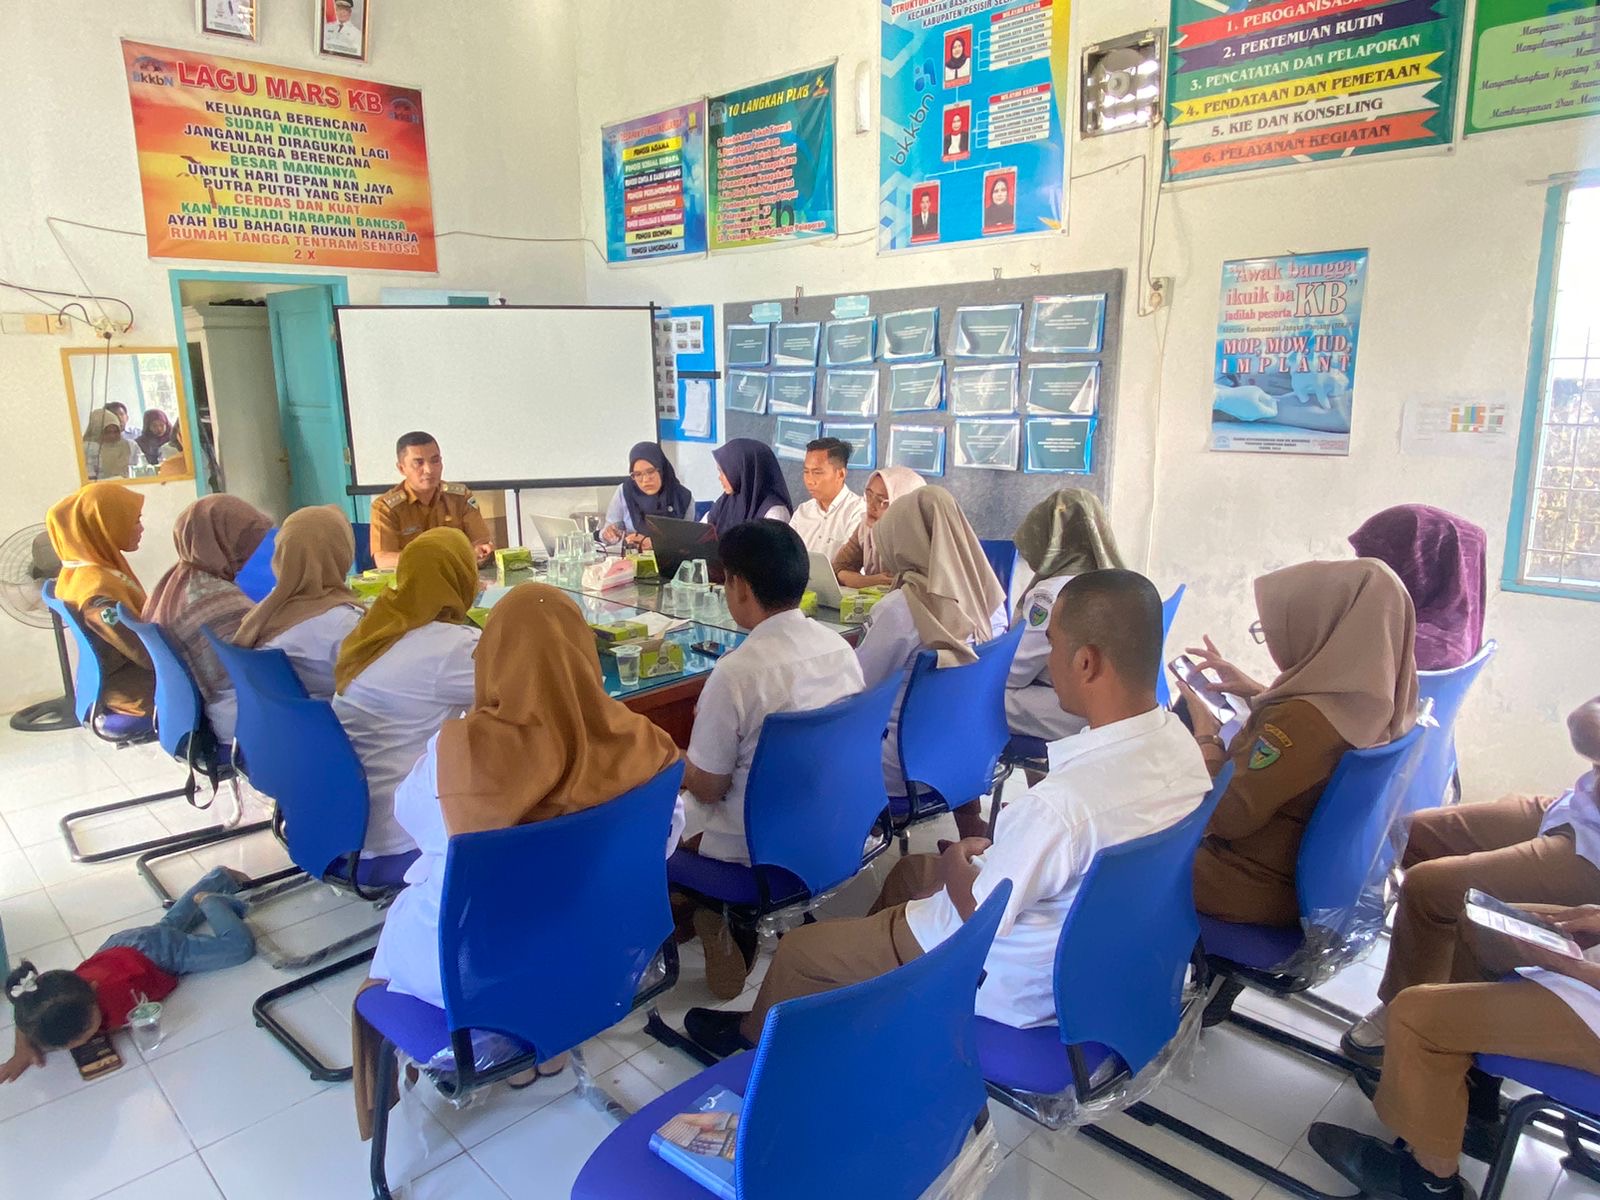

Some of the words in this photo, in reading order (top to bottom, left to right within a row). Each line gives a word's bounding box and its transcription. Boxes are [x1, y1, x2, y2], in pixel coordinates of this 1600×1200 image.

[908, 2, 947, 21] KECAMATAN
[923, 9, 962, 27] KABUPATEN
[1227, 19, 1239, 32] 1.
[1243, 0, 1362, 28] PEROGANISA
[1223, 46, 1236, 58] 2.
[1240, 24, 1331, 55] PERTEMUAN
[1335, 12, 1384, 35] RUTIN
[1190, 79, 1202, 91] 3.
[1206, 60, 1289, 89] PENCATATAN
[1293, 53, 1323, 70] DAN
[1327, 33, 1420, 64] PELAPORAN
[176, 60, 257, 96] LAGU
[264, 76, 341, 109] MARS
[347, 89, 384, 115] KB
[1186, 105, 1199, 117] 4.
[1204, 87, 1289, 114] PENDATAAN
[1293, 80, 1327, 97] DAN
[1331, 63, 1420, 90] PEMETAAN
[205, 101, 282, 121] KELUARGA
[286, 113, 368, 133] BERENCANA
[728, 103, 740, 118] 10
[741, 90, 784, 114] LANGKAH
[1211, 125, 1224, 137] 5.
[1229, 120, 1252, 134] KIE
[1257, 114, 1289, 129] DAN
[1293, 97, 1383, 123] KONSELING
[184, 124, 273, 145] JANGANLAH
[278, 135, 356, 155] DIRAGUKAN
[361, 147, 389, 159] LAGI
[224, 116, 274, 132] SUDAH
[279, 124, 354, 143] WAKTUNYA
[890, 94, 934, 165] bkkbn
[1202, 152, 1215, 163] 6.
[1220, 138, 1305, 161] PELAYANAN
[1309, 124, 1391, 147] KEGIATAN
[210, 140, 286, 159] KELUARGA
[290, 149, 371, 169] BERENCANA
[230, 155, 277, 170] BESAR
[282, 161, 357, 179] MAKNANYA
[188, 163, 240, 179] UNTUK
[244, 169, 279, 183] HARI
[284, 173, 328, 188] DEPAN
[333, 179, 359, 191] NAN
[364, 182, 394, 195] JAYA
[203, 177, 253, 192] PUTRA
[258, 183, 300, 197] PUTRI
[304, 187, 339, 201] YANG
[344, 192, 384, 206] SEHAT
[181, 202, 212, 215] KAN
[218, 205, 283, 220] MENJADI
[288, 211, 351, 226] HARAPAN
[356, 217, 406, 230] BANGSA
[234, 193, 291, 209] CERDAS
[296, 199, 323, 212] DAN
[328, 202, 361, 215] KUAT
[168, 214, 207, 227] AYAH
[213, 217, 238, 229] IBU
[244, 219, 306, 235] BAHAGIA
[311, 225, 356, 238] RUKUN
[361, 229, 418, 243] RAHARJA
[170, 227, 228, 241] RUMAH
[233, 231, 290, 245] TANGGA
[295, 235, 358, 250] TENTRAM
[362, 240, 419, 255] SENTOSA
[294, 249, 302, 259] 2
[307, 250, 316, 260] X
[1288, 260, 1357, 280] bangga
[1226, 286, 1270, 306] ikuik
[1273, 284, 1295, 303] ba
[1225, 309, 1256, 322] jadilah
[1258, 308, 1292, 321] peserta
